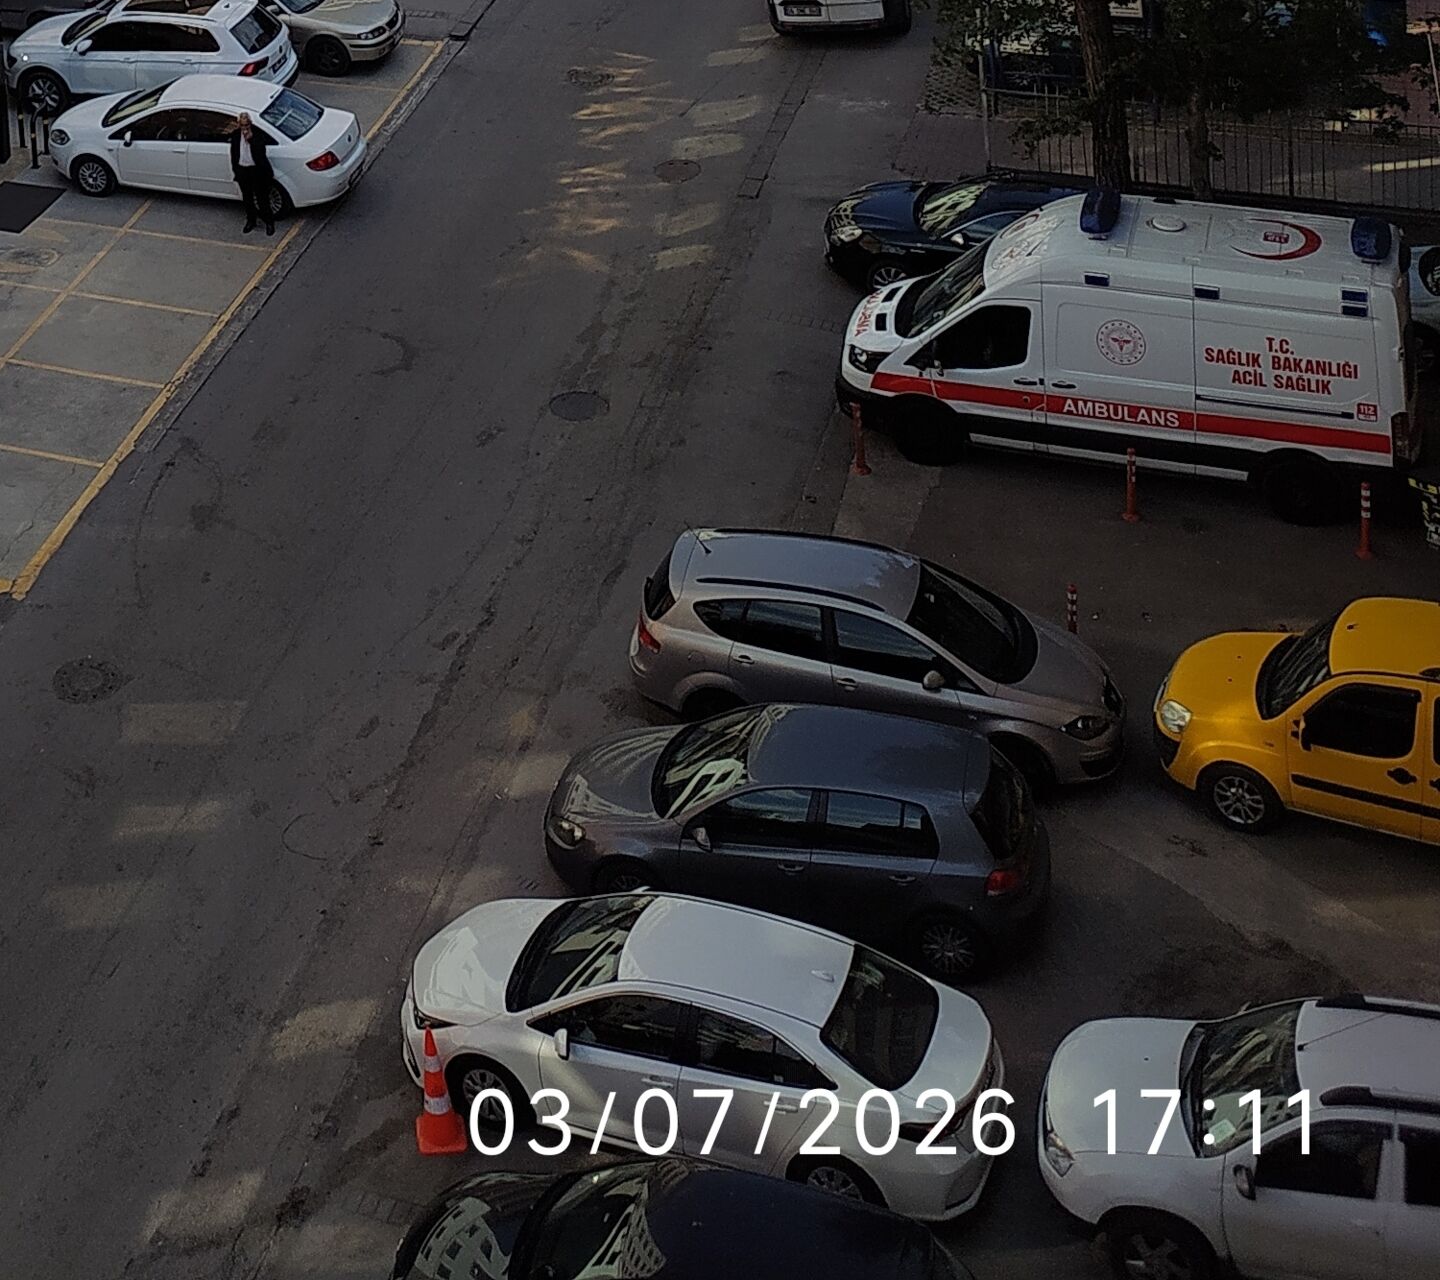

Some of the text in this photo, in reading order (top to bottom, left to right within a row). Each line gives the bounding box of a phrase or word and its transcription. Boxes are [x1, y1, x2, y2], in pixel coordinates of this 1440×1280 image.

[1266, 336, 1295, 355] T.C.
[1204, 346, 1359, 380] SAĞLIK BAKANLIĞI
[1232, 368, 1332, 396] ACİL SAĞLIK
[1063, 398, 1180, 428] AMBULANS
[1359, 405, 1376, 416] 112
